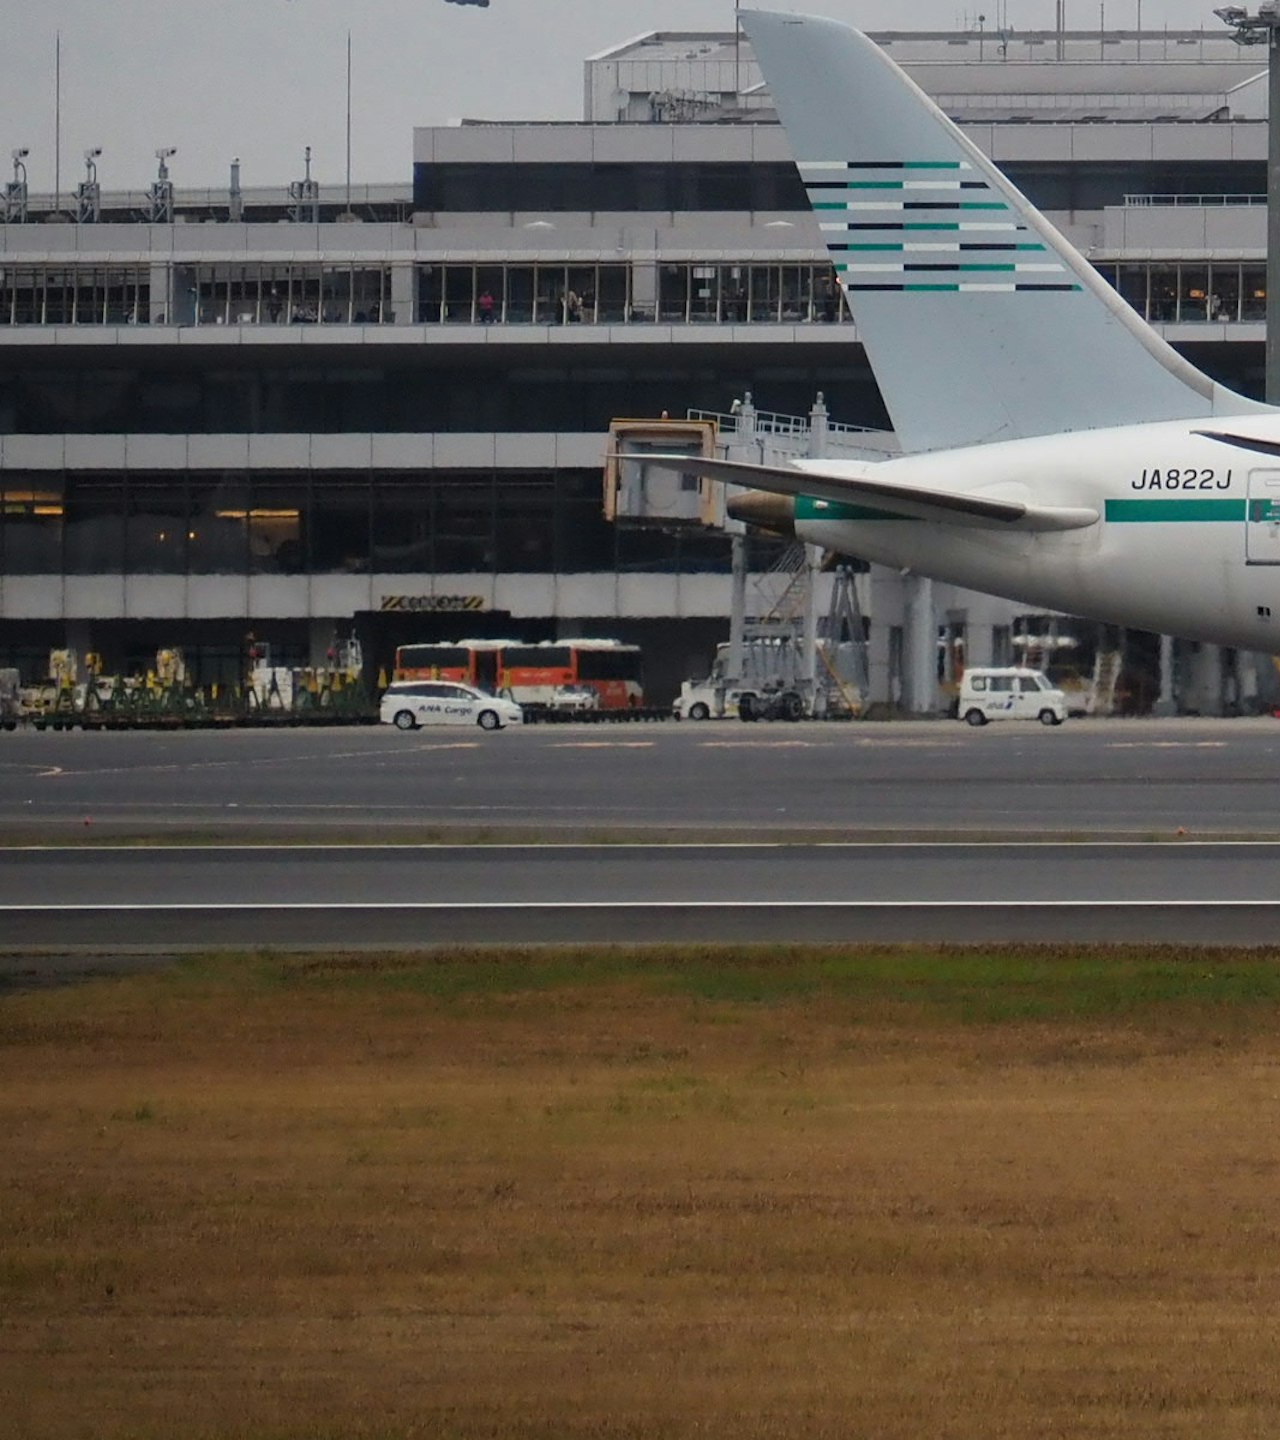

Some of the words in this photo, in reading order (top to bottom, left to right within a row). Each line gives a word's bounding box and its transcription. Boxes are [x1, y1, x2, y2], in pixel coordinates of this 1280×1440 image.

[1131, 469, 1232, 490] JA822J
[418, 704, 441, 712] ANA
[444, 706, 473, 716] Cargo
